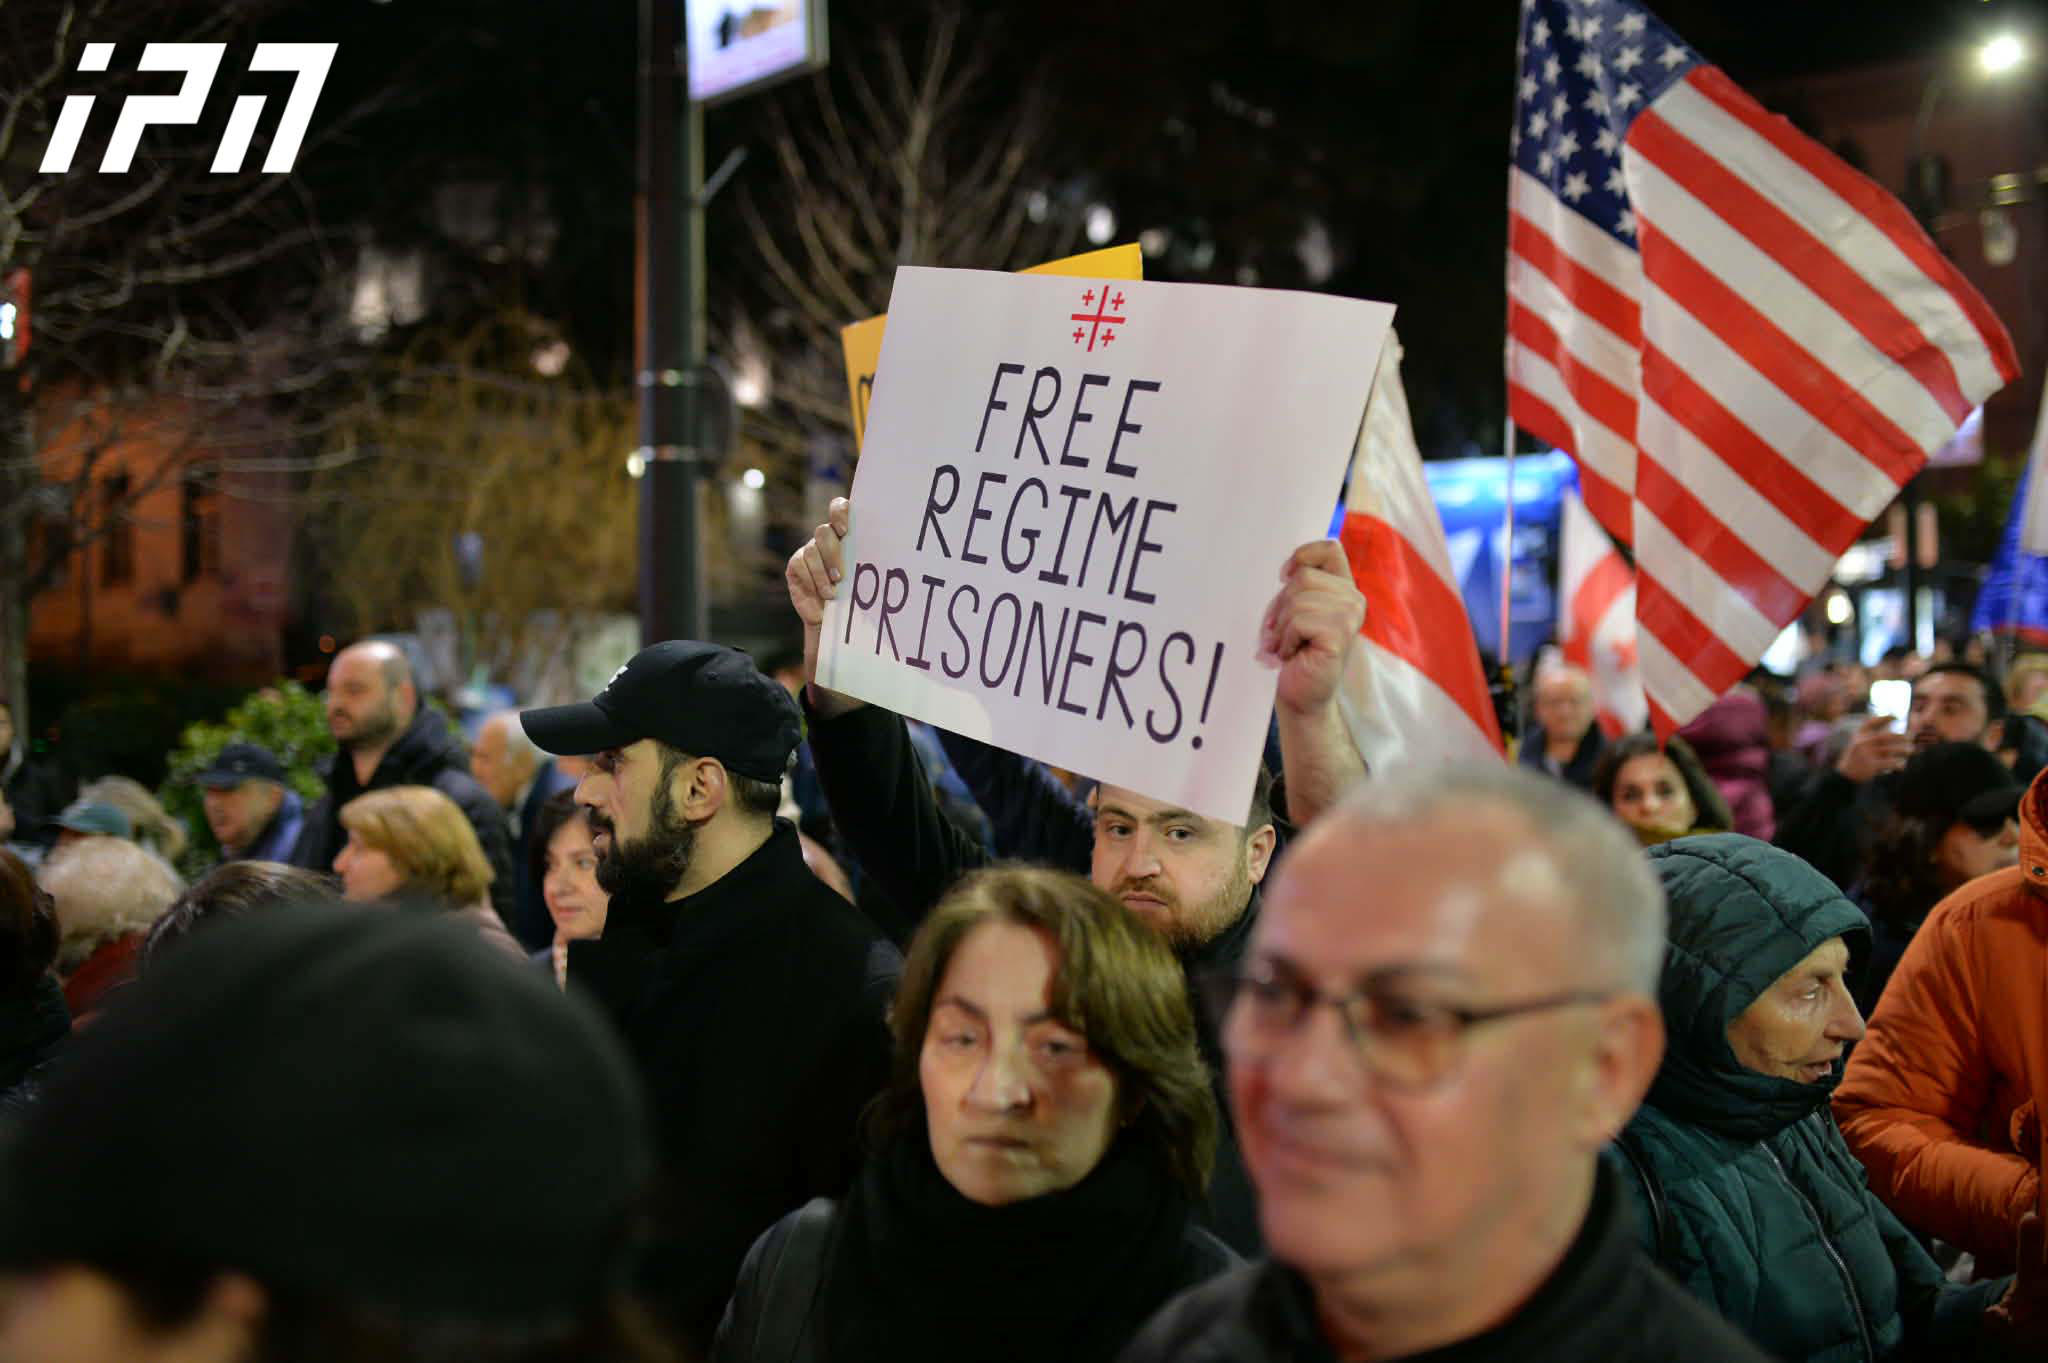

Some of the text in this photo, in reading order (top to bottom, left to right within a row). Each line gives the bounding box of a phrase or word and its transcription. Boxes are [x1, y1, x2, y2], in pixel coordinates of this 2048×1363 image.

[974, 362, 1162, 478] FREE
[915, 464, 1177, 605] REGIME
[844, 562, 1225, 750] PRISONERS!
